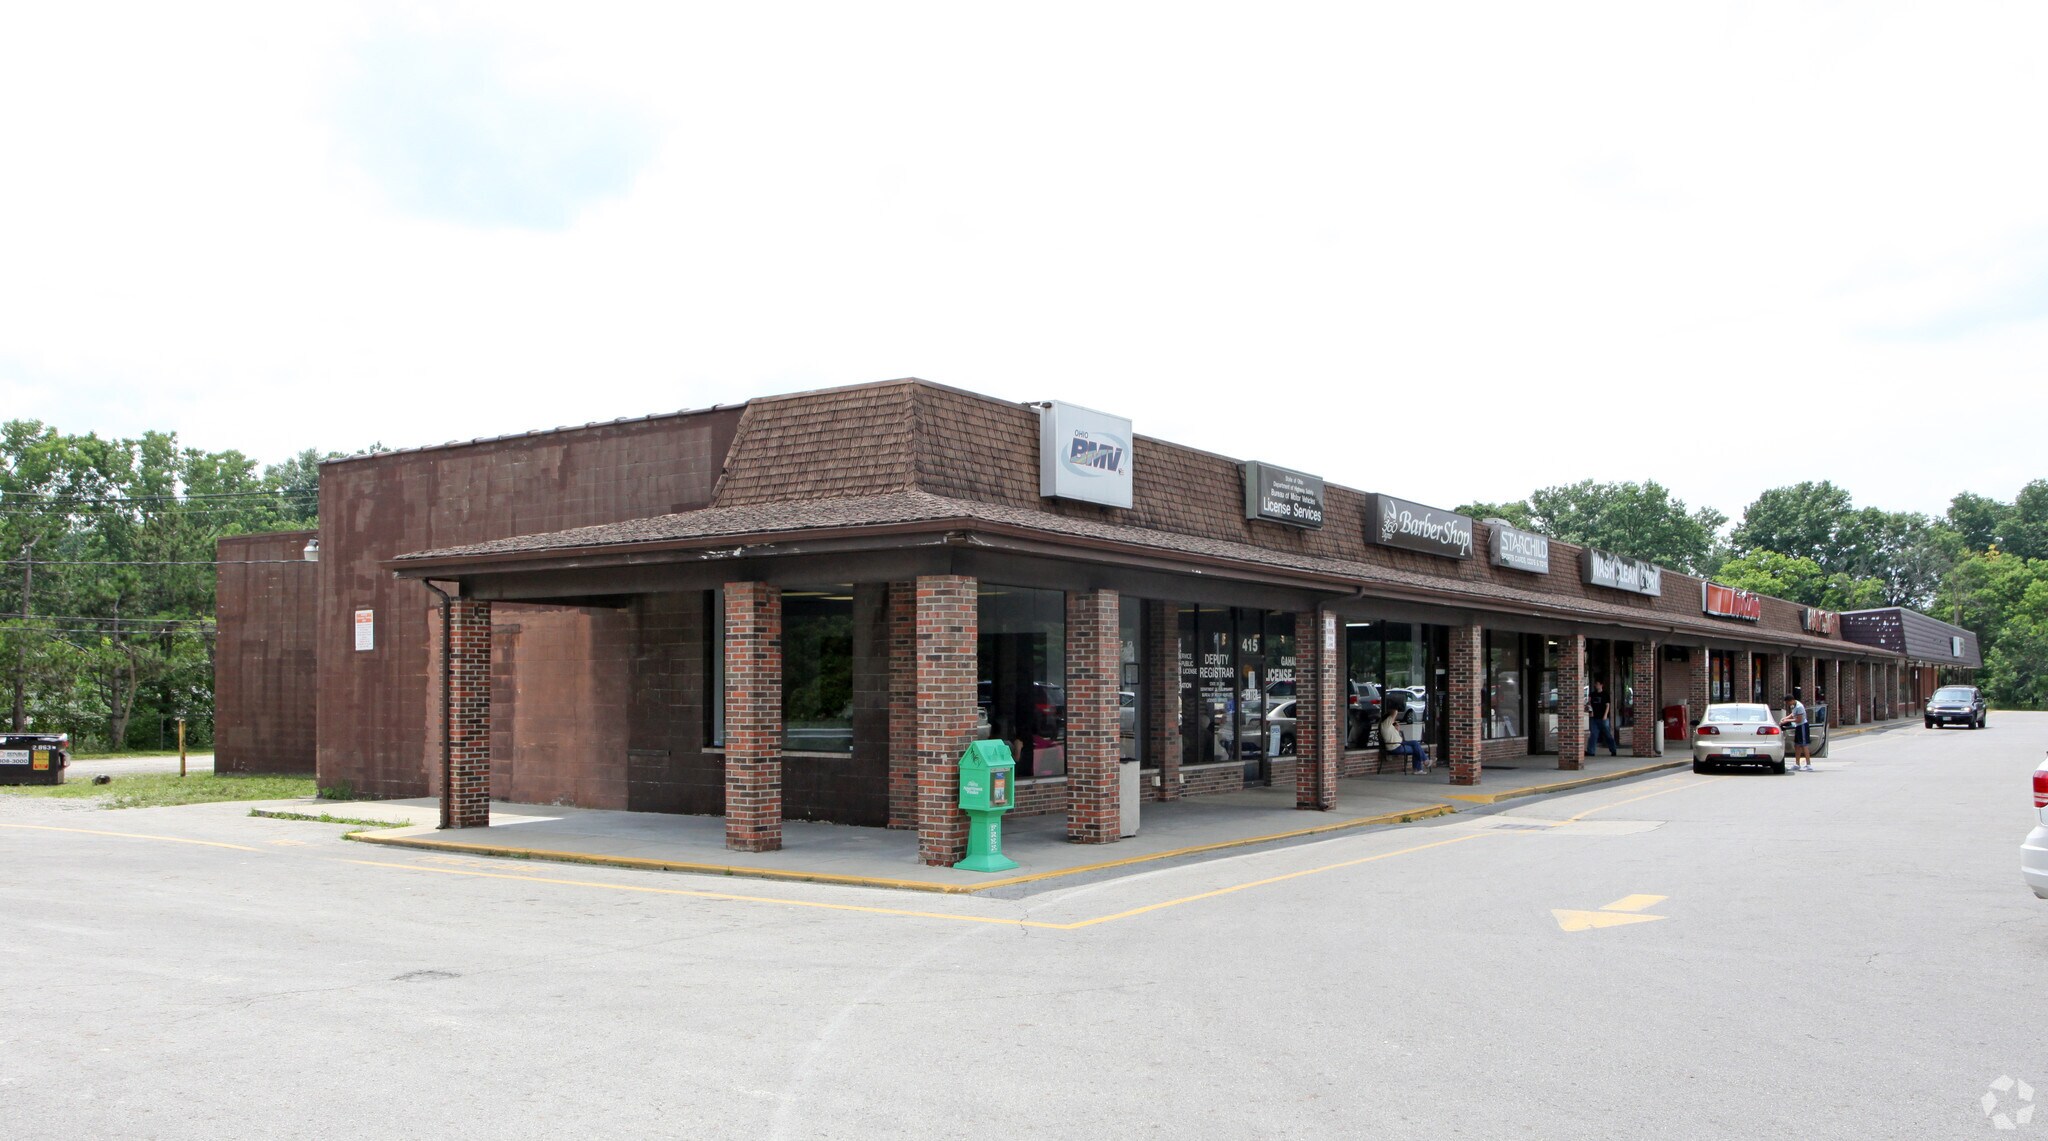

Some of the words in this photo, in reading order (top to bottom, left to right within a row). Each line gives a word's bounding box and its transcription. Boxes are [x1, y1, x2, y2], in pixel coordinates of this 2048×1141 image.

[1075, 430, 1088, 438] OHIO
[1070, 438, 1123, 472] BMV
[1272, 481, 1290, 490] Department
[1271, 488, 1284, 498] Bureau
[1284, 492, 1290, 500] of
[1290, 492, 1302, 502] Motor
[1302, 495, 1315, 505] Vehicles
[1264, 496, 1291, 515] License
[1293, 503, 1321, 521] Services
[1381, 520, 1399, 534] 360
[1501, 531, 1548, 559] STARCHILD
[1593, 553, 1615, 580] WASH
[1242, 638, 1258, 652] 415
[1204, 653, 1229, 665] DEPUTY
[1199, 666, 1235, 679] REGISTRAR
